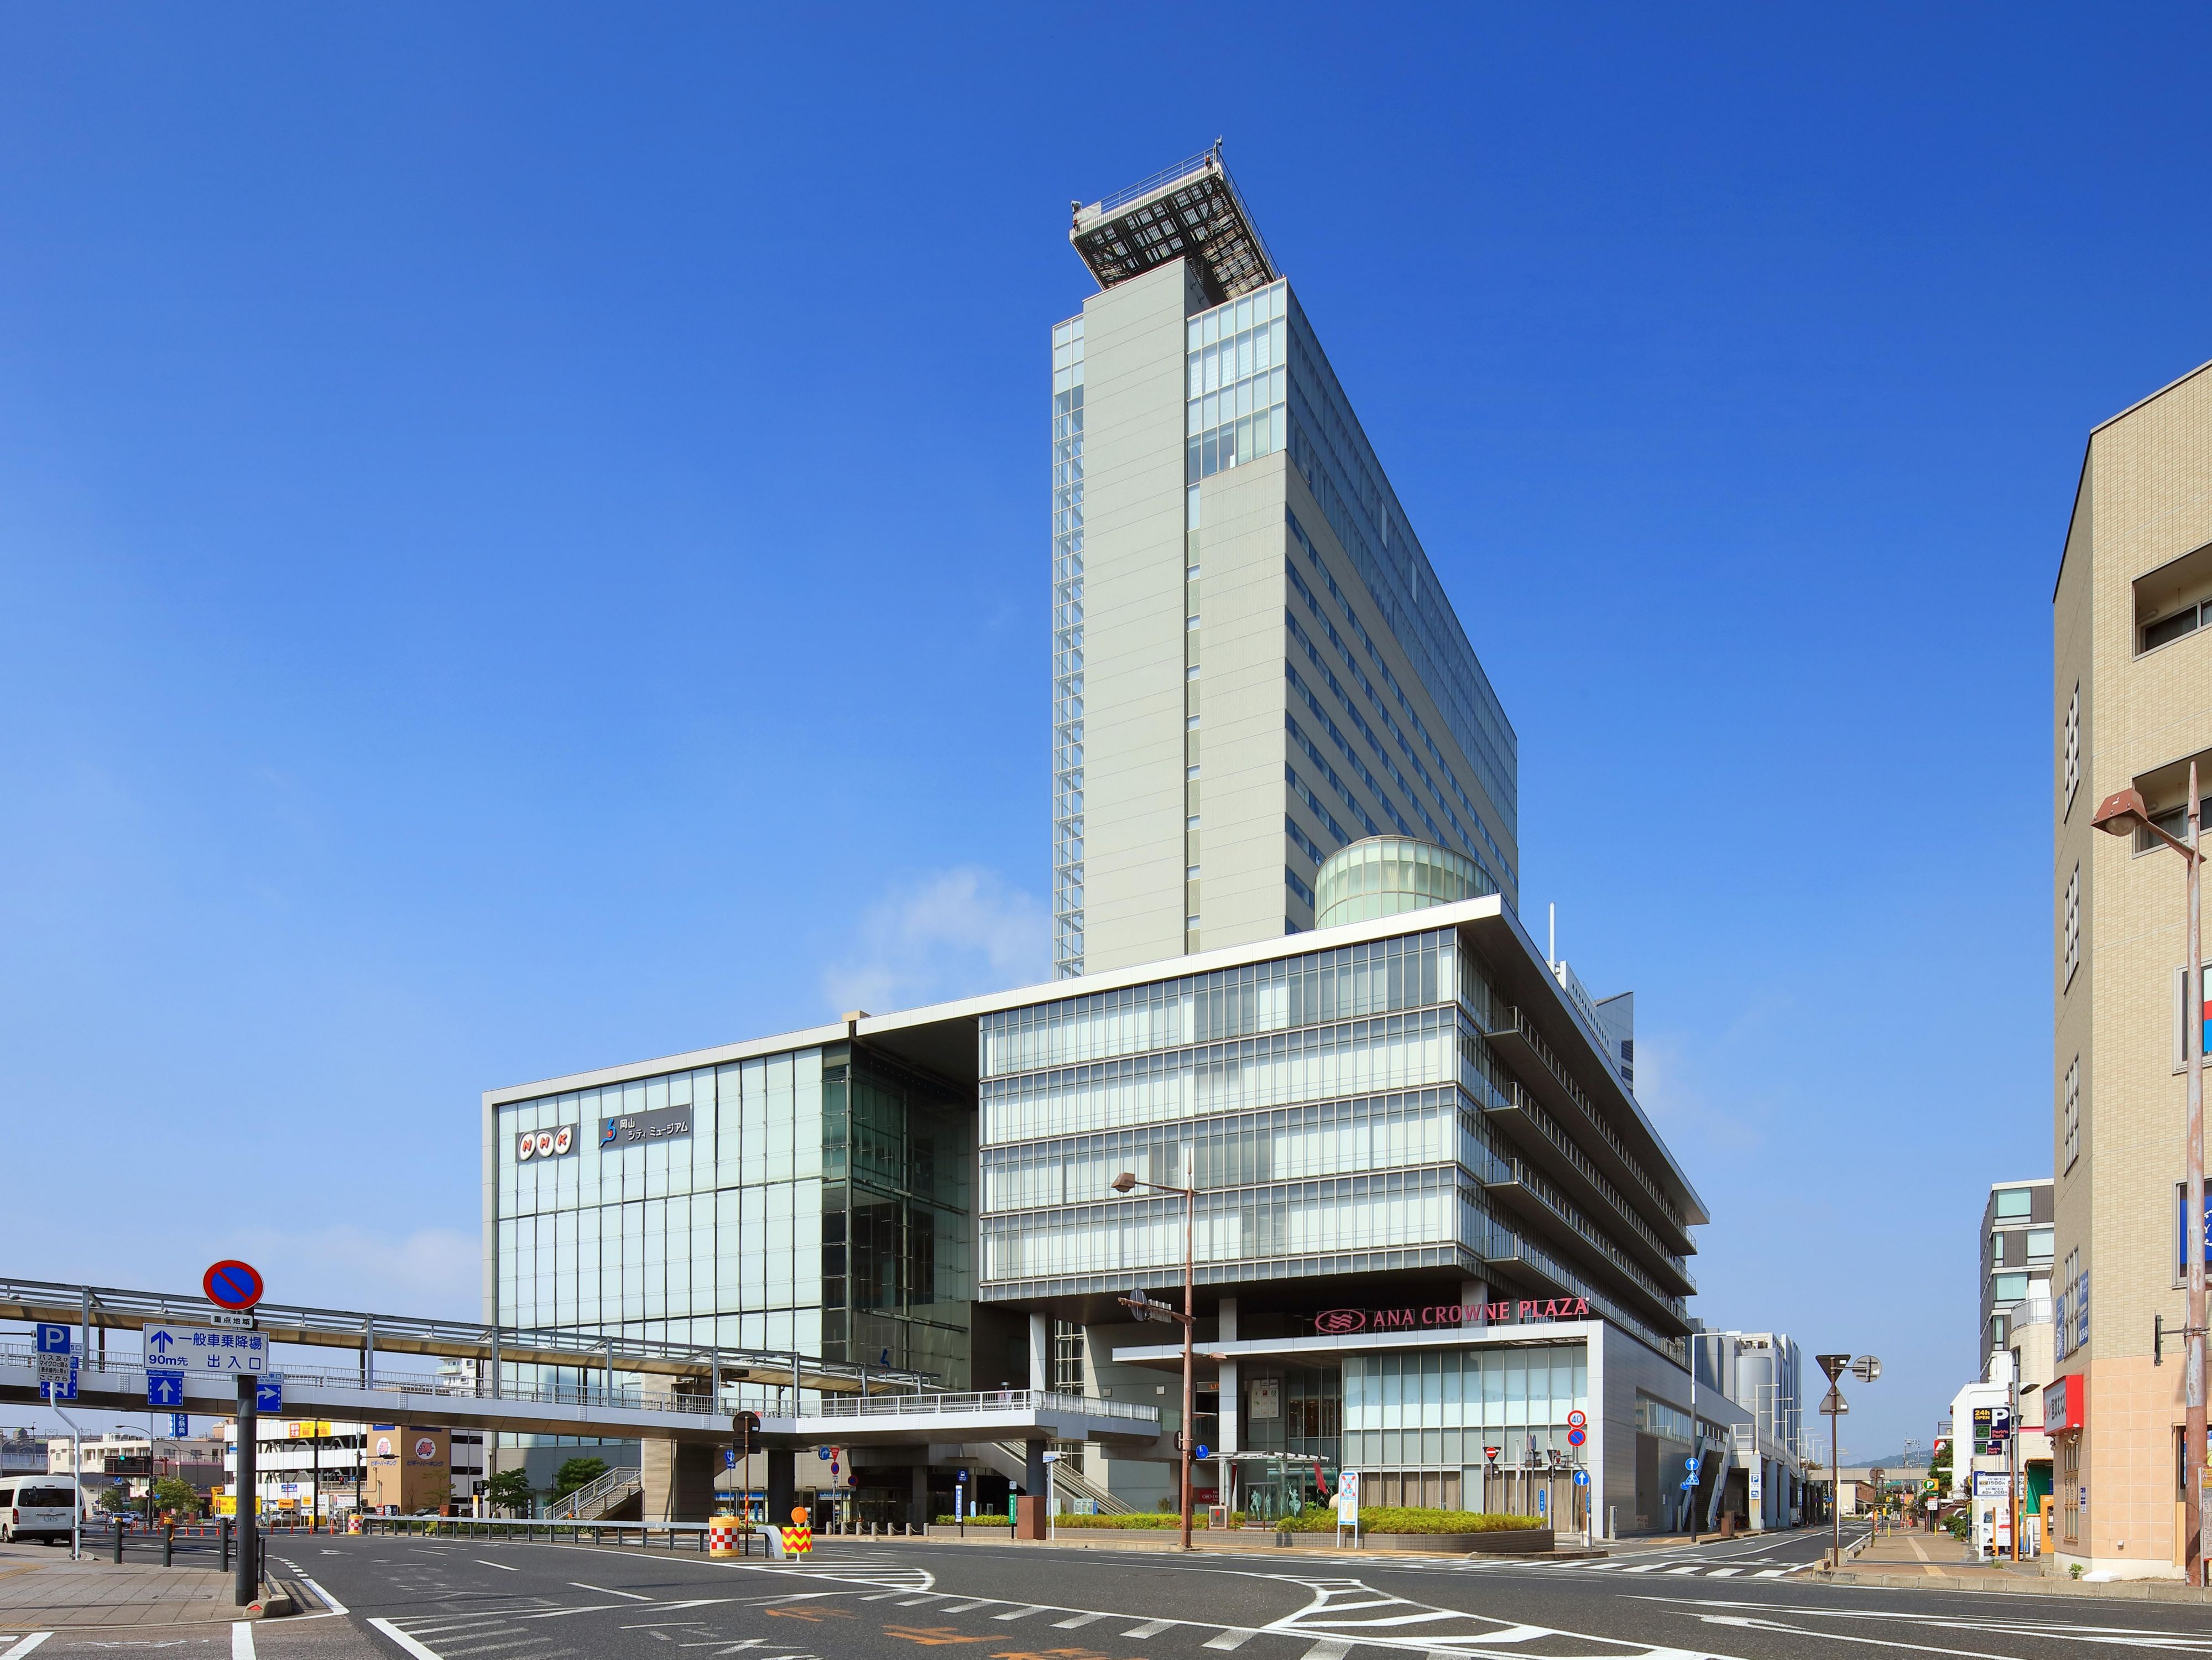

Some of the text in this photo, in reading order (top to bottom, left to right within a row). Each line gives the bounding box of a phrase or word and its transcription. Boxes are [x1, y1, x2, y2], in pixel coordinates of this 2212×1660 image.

[619, 1117, 635, 1130] 岡山
[522, 1133, 566, 1152] NHK
[213, 1316, 250, 1325] 重点地域
[1373, 1297, 1589, 1327] ANA CROWNE PLAZA
[46, 1327, 65, 1350] P
[178, 1332, 262, 1350] 一般車乗降場
[149, 1354, 189, 1366] 90m先
[1572, 1415, 1582, 1423] 40
[1992, 1408, 2009, 1427] P
